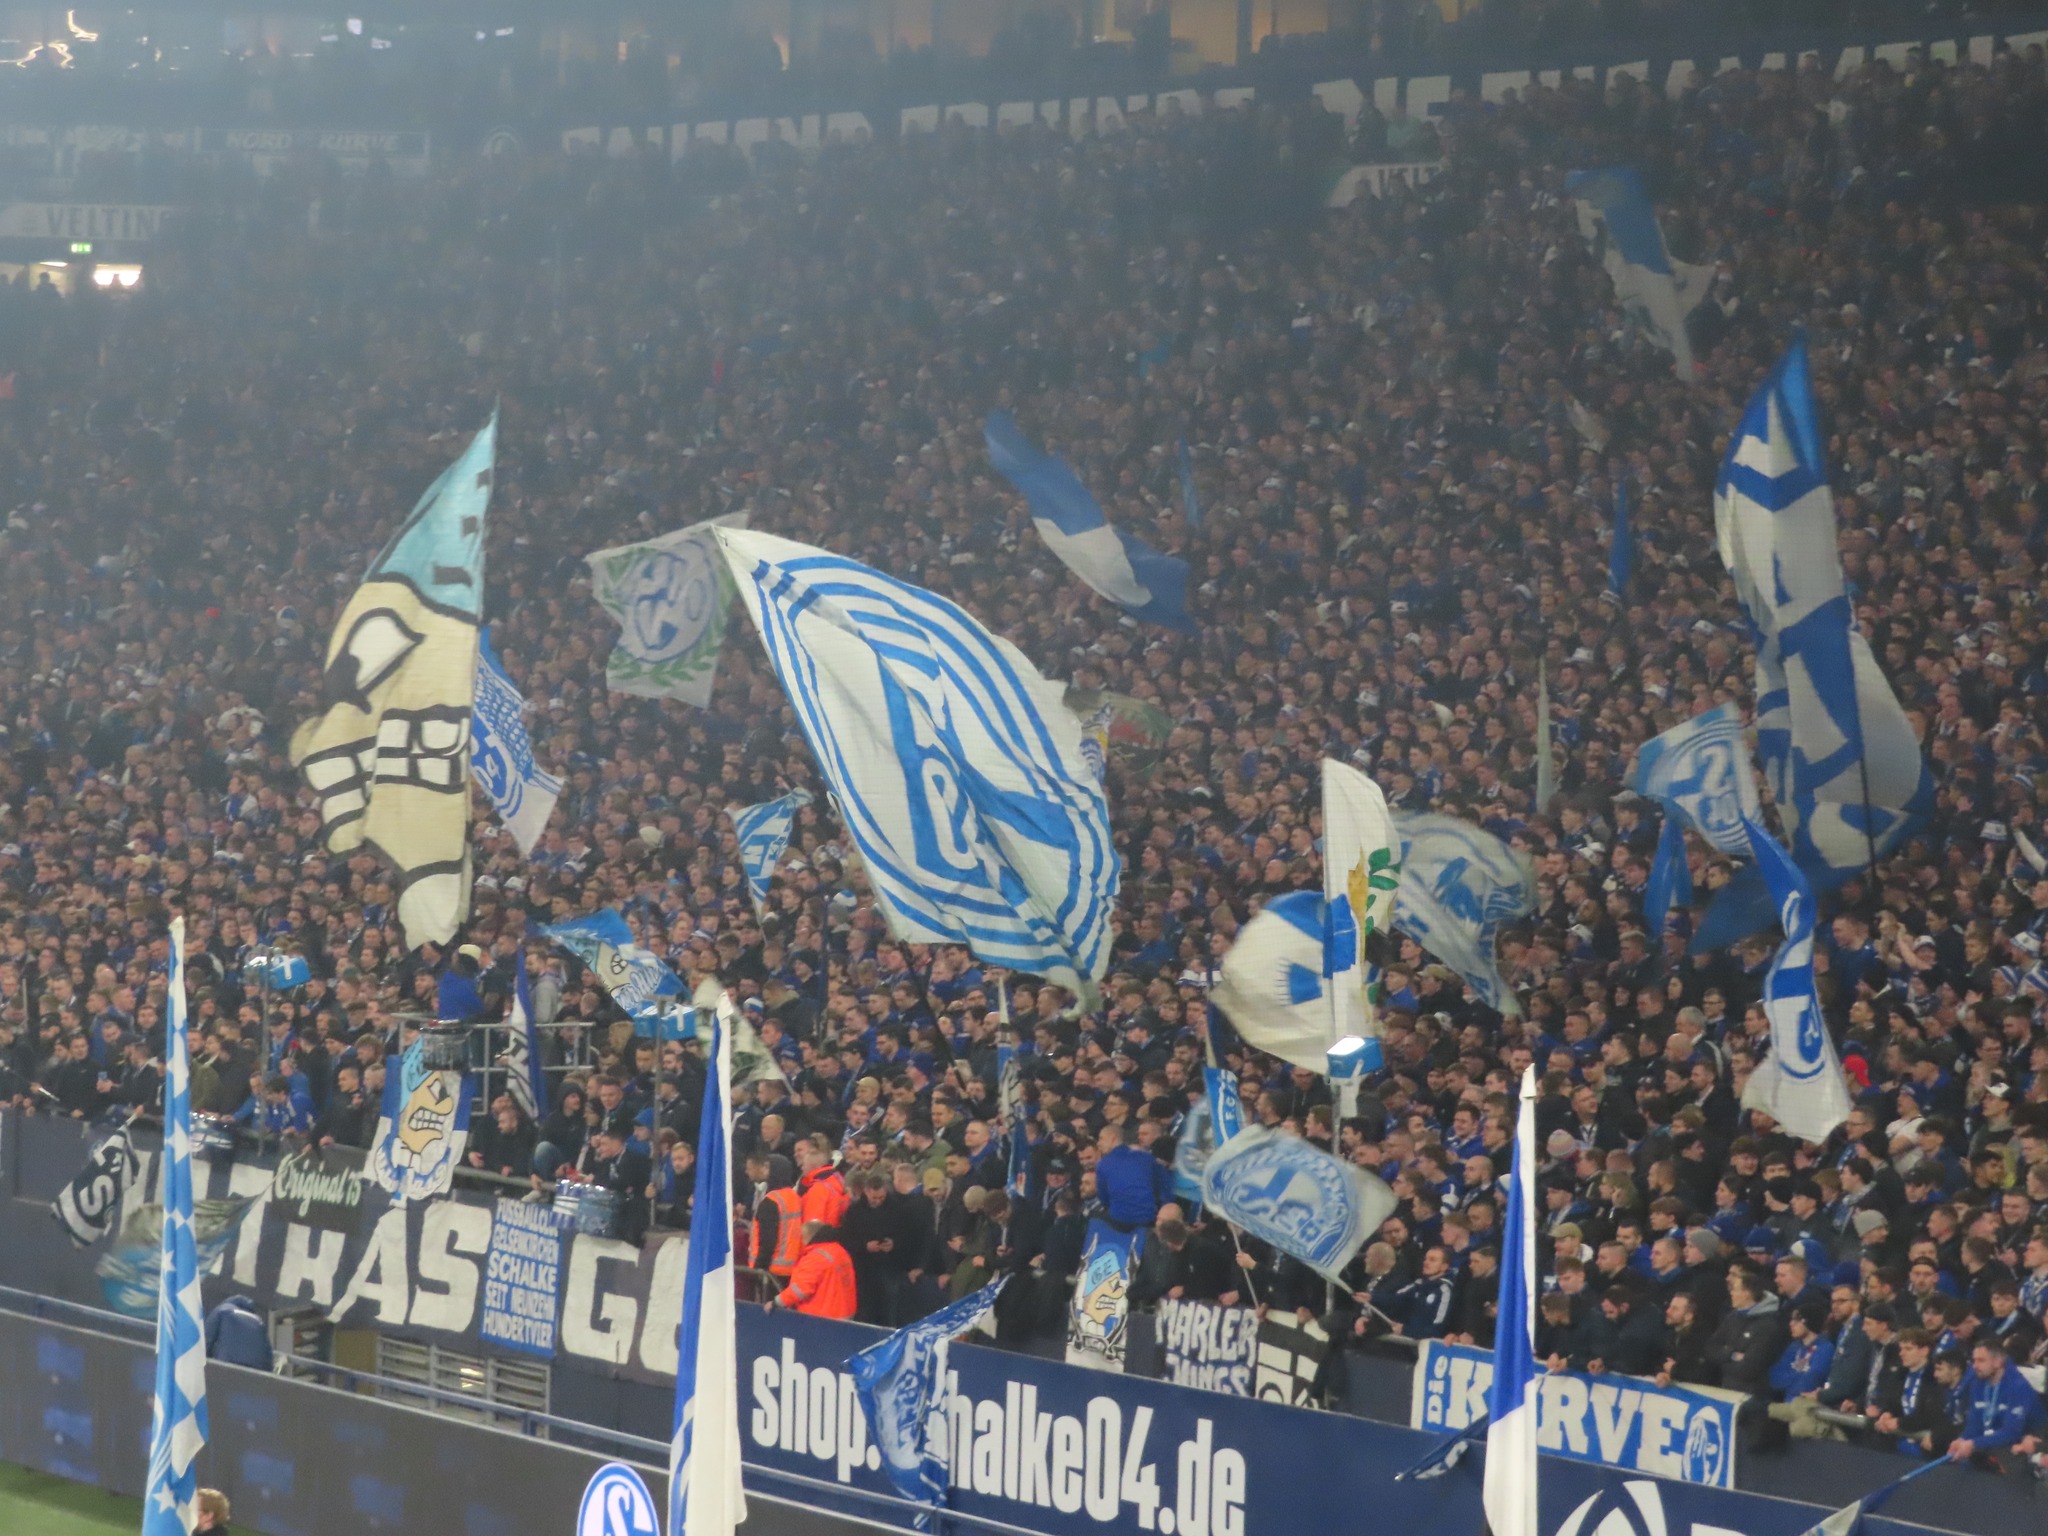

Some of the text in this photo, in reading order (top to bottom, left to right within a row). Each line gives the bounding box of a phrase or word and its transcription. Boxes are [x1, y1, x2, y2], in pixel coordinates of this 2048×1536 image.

[485, 1280, 509, 1311] SEIT
[487, 1250, 557, 1294] SCHALKE
[483, 1309, 554, 1350] HUNDERTVIER
[1155, 1298, 1260, 1368] MARLER
[751, 1337, 1248, 1536] shop.halke04.de
[1445, 1356, 1690, 1480] KRVE
